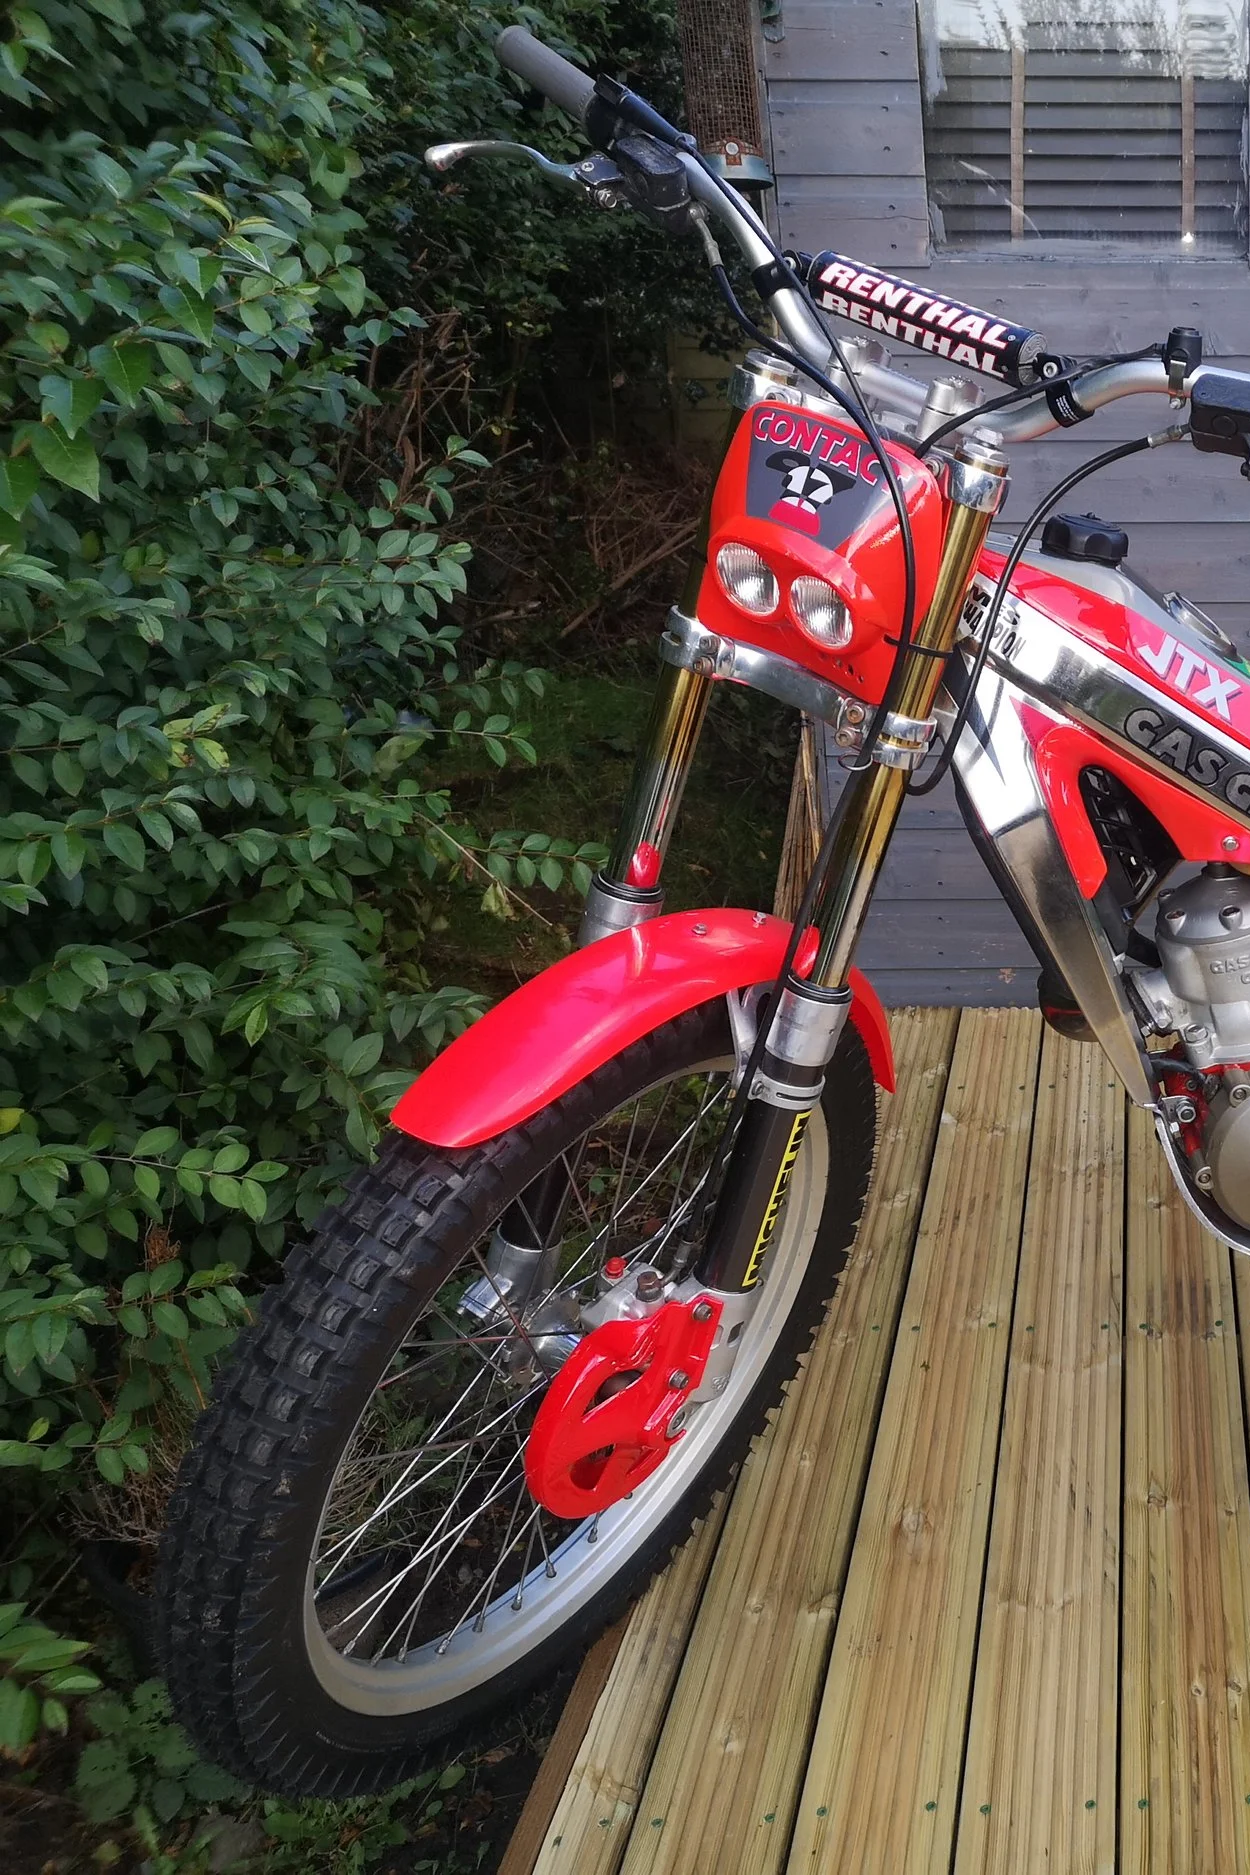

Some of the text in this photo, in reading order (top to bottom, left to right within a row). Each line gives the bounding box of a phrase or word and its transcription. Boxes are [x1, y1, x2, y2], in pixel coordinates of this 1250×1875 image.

[818, 290, 1005, 378] RENTHAL
[819, 261, 1008, 349] RENTHAL
[1138, 632, 1243, 721] JTX
[1124, 707, 1230, 787] GAS
[1210, 954, 1250, 975] GAS
